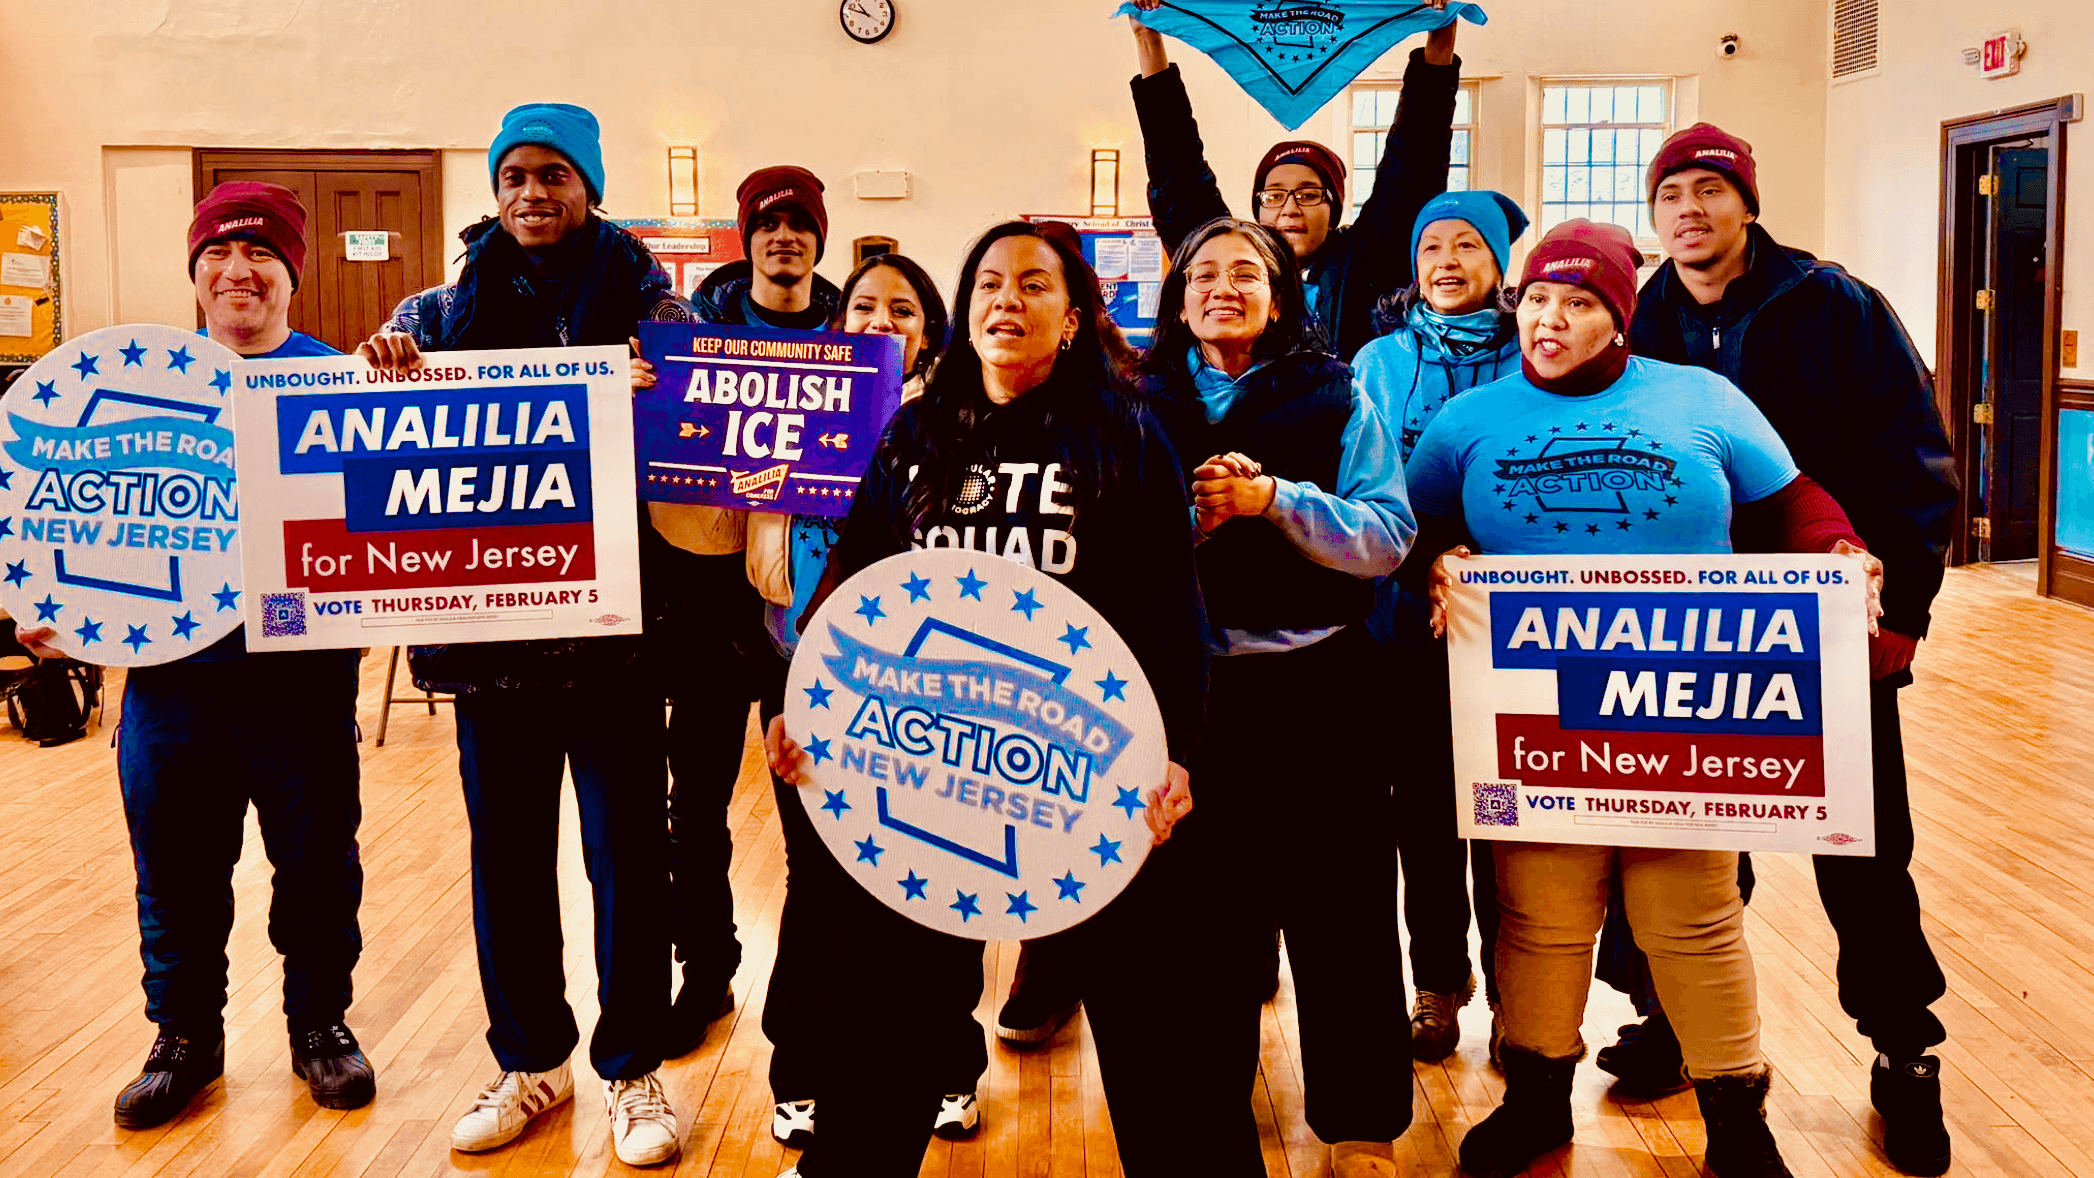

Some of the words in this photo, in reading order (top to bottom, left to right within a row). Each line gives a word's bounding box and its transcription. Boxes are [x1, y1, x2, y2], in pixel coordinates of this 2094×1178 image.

[1260, 11, 1288, 20] MAKE
[1310, 10, 1339, 22] ROAD
[1260, 22, 1335, 36] ACTION
[1984, 36, 2006, 72] EXIT
[1694, 149, 1735, 160] ANALILIA
[758, 188, 794, 210] ANALILIA
[218, 217, 264, 233] ANALILIA
[1125, 220, 1150, 228] Christ
[645, 242, 660, 250] Our
[662, 242, 706, 251] Leadership
[1543, 257, 1592, 272] ANALILIA
[693, 336, 722, 354] KEEP
[724, 339, 748, 356] OUR
[750, 340, 823, 361] COMMUNITY
[824, 344, 853, 362] SAFE
[246, 371, 361, 389] UNBOUGHT.
[366, 366, 472, 384] UNBOSSED.
[478, 365, 514, 380] FOR
[519, 364, 551, 379] ALL
[559, 363, 580, 378] OF
[586, 362, 614, 376] US.
[684, 368, 852, 413] ABOLISH
[294, 400, 576, 454] ANALILIA
[722, 410, 805, 462] ICE
[32, 436, 112, 461] MAKE
[116, 430, 173, 456] THE
[176, 432, 236, 469] ROA
[1508, 460, 1564, 476] MAKE
[1564, 454, 1604, 467] THE
[1608, 454, 1668, 471] ROAD
[384, 463, 576, 517] MEJIA
[737, 468, 782, 491] ANALILIA
[1508, 470, 1666, 498] ACTION
[24, 467, 238, 522] ACTION
[20, 517, 104, 546] NEW
[106, 522, 238, 553] JERSEY
[301, 541, 353, 578] for
[366, 541, 452, 575] New
[464, 538, 579, 576] Jersey
[1459, 570, 1574, 585] UNBOUGHT.
[1580, 570, 1692, 585] UNBOSSED.
[1698, 570, 1738, 585] FOR
[1744, 570, 1777, 585] ALL
[1783, 570, 1811, 585] OF
[1816, 570, 1850, 585] US.
[313, 600, 362, 616] VOTE
[372, 594, 478, 614] THURSDAY,
[486, 590, 582, 608] FEBRUARY
[588, 589, 598, 603] 5
[1507, 607, 1804, 653] ANALILIA
[852, 657, 942, 698] MAKE
[948, 674, 1016, 708] THE
[1018, 688, 1111, 754] ROAD
[1599, 670, 1804, 721] MEJIA
[845, 693, 1092, 804] ACTION
[1514, 736, 1566, 772] for
[1580, 740, 1670, 775] New
[1683, 744, 1806, 788] Jersey
[840, 743, 932, 791] NEW
[934, 774, 1084, 836] JERSEY
[1526, 795, 1576, 812] VOTE
[1585, 797, 1695, 818] THURSDAY,
[1704, 802, 1808, 821] FEBRUARY
[1816, 806, 1828, 821] 5
